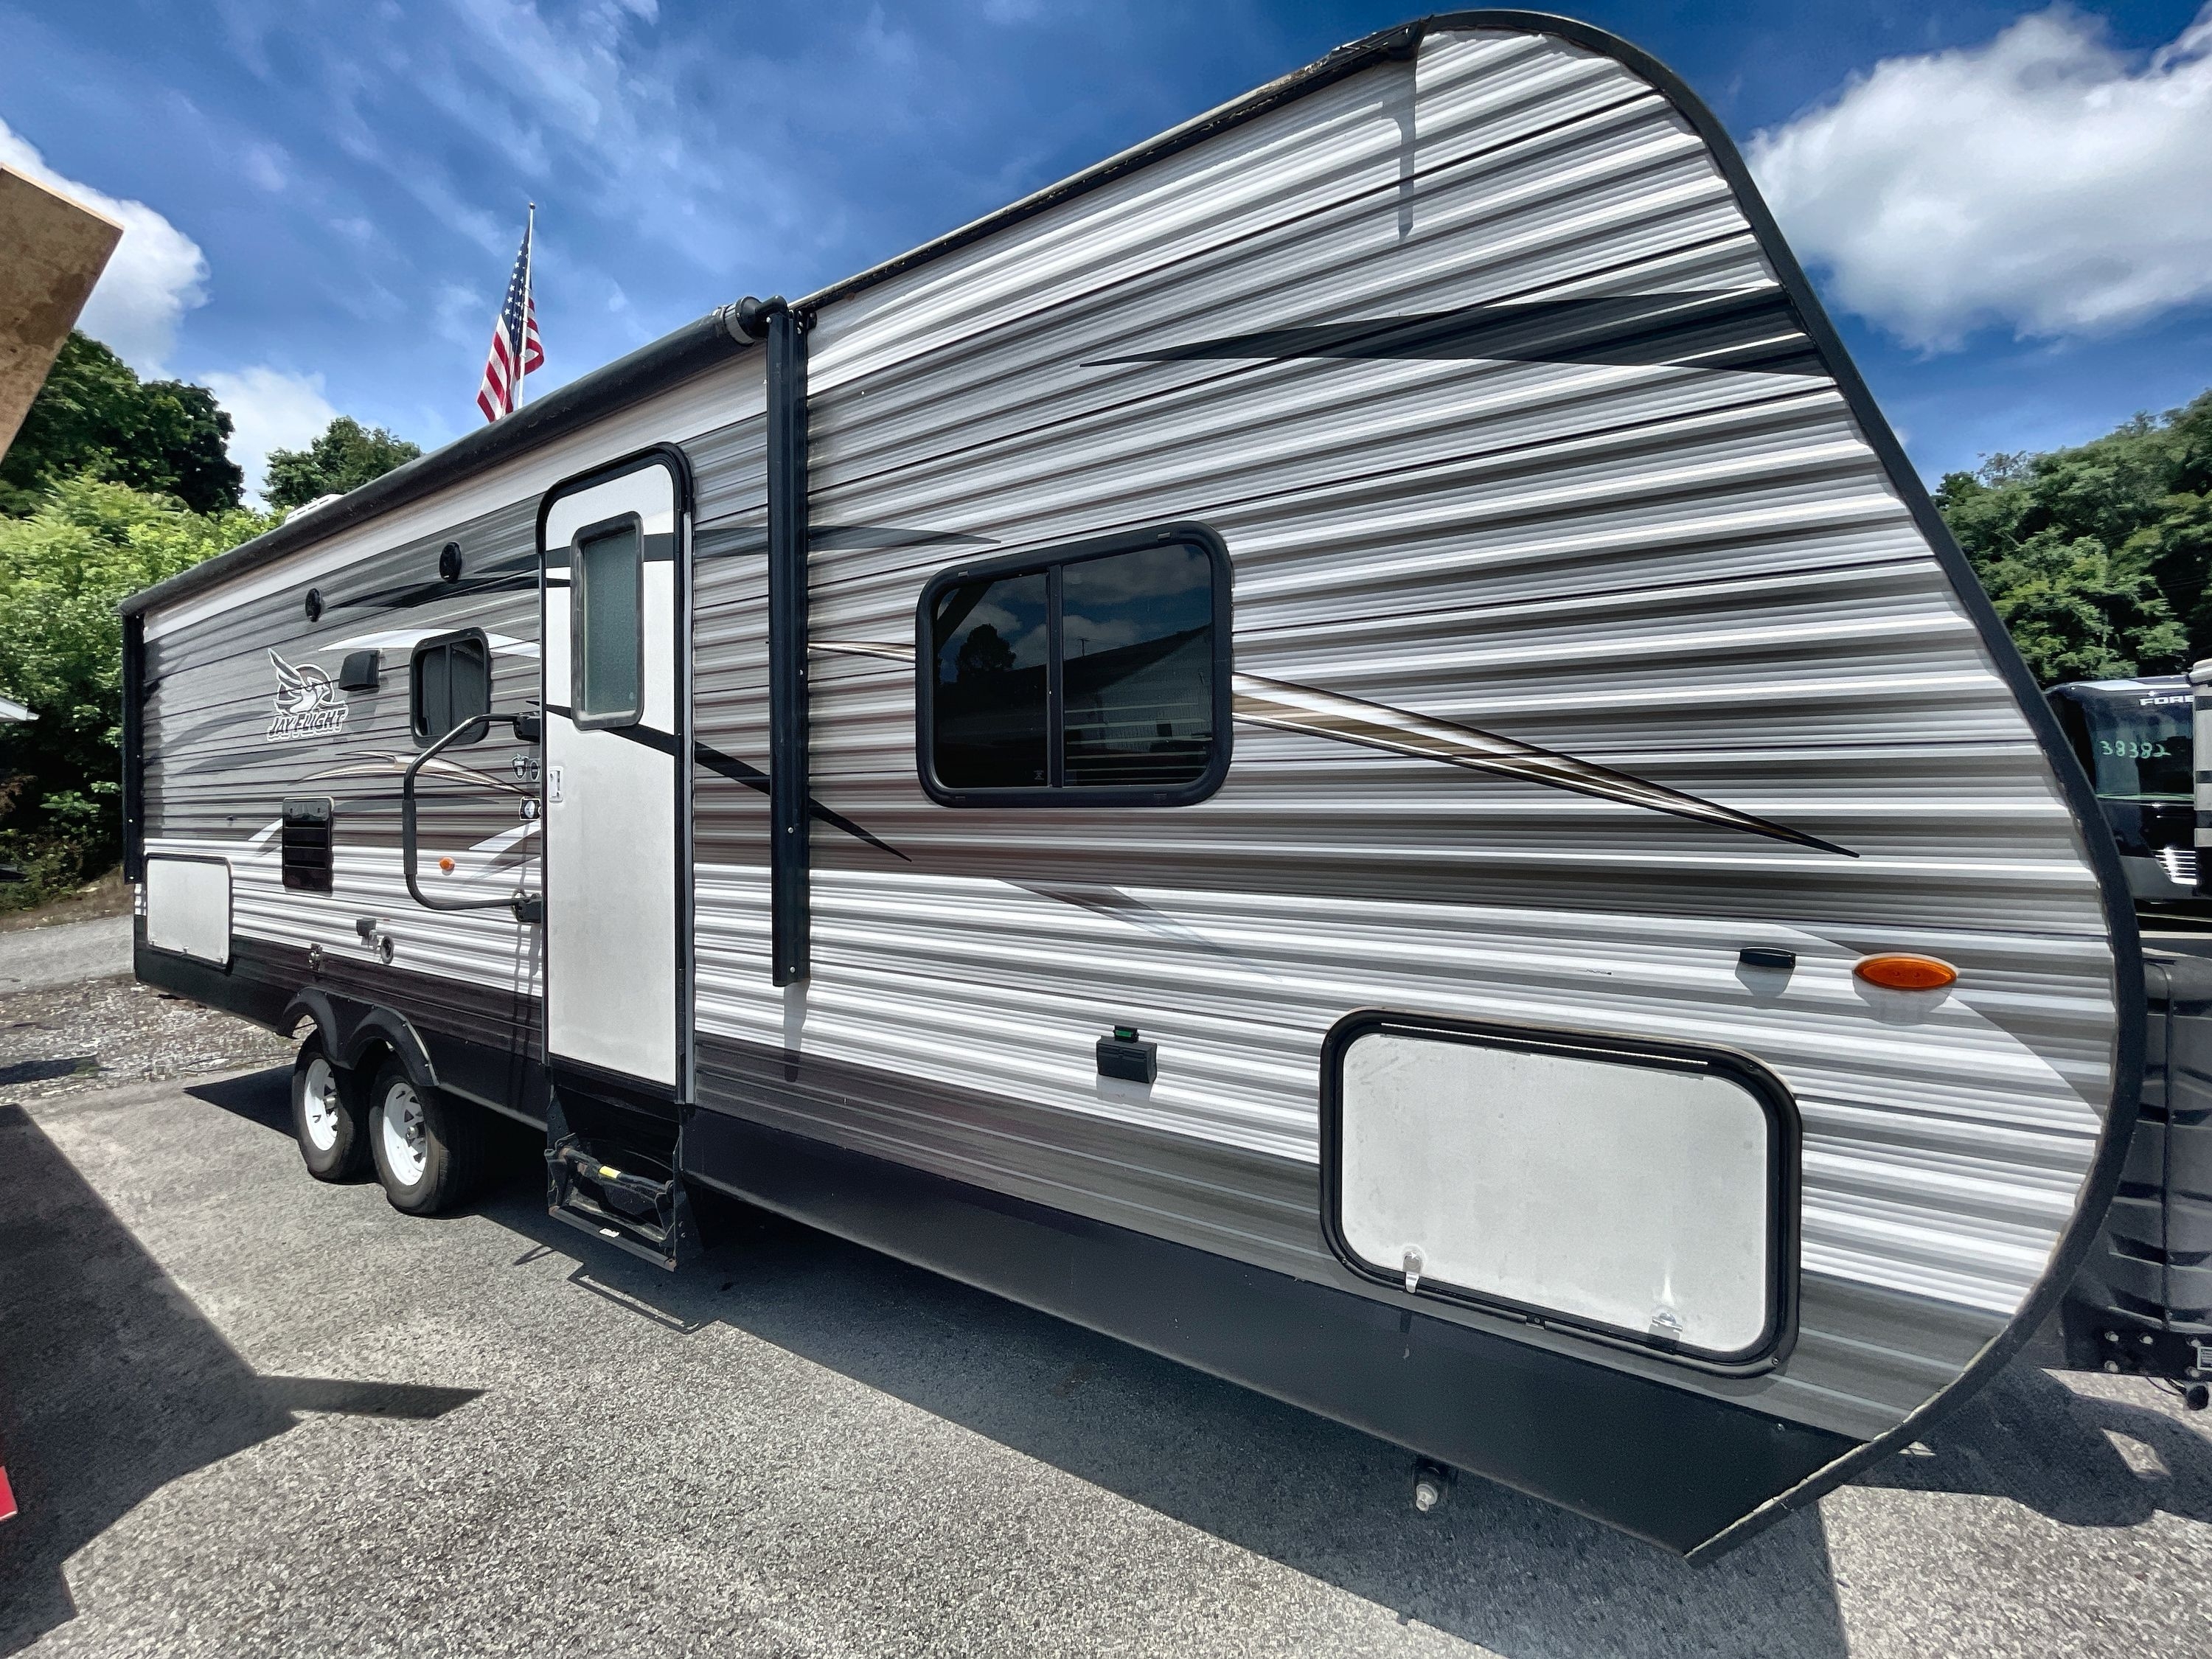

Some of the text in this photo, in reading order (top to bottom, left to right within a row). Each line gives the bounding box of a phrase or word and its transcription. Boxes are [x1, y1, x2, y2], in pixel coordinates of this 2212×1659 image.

[268, 707, 348, 739] JAY FLIGHT
[2100, 740, 2171, 759] 38382
